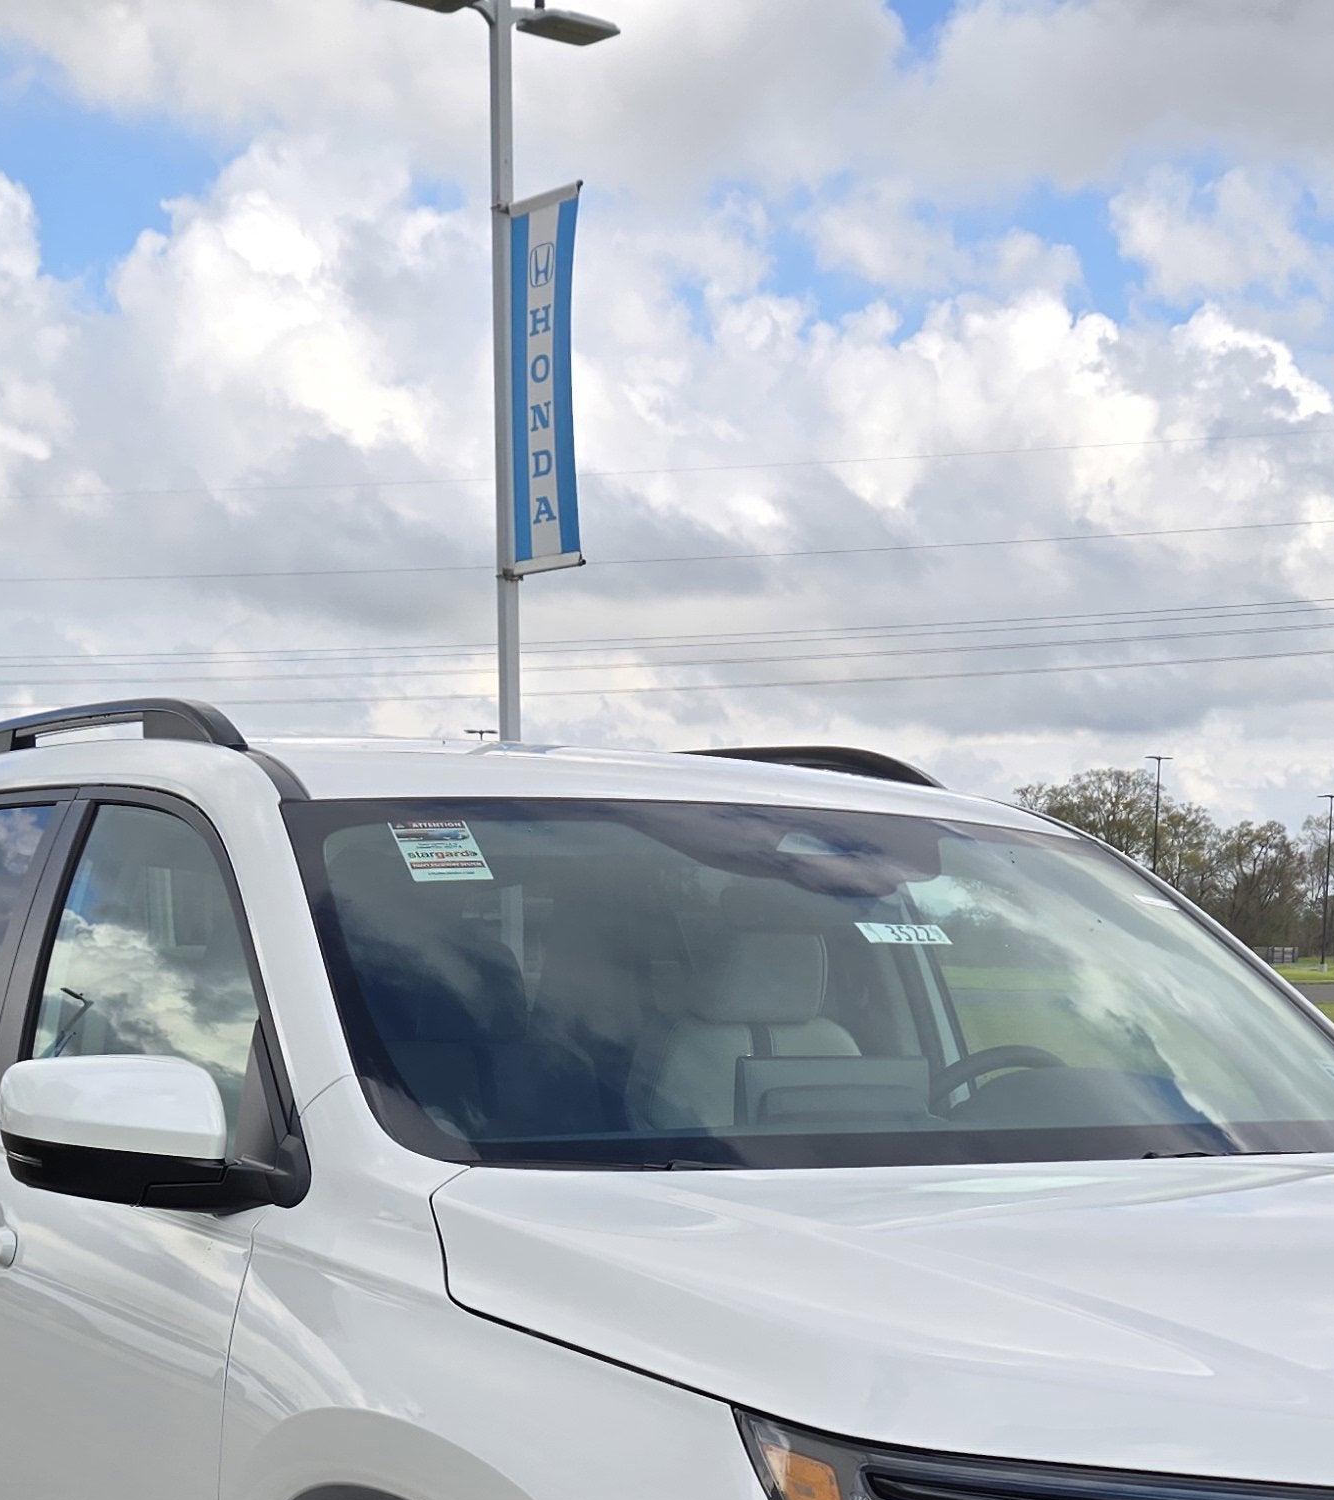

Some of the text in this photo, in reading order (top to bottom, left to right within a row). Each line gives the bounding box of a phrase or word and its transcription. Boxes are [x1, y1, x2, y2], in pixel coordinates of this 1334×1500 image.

[528, 305, 557, 525] HONDA
[411, 821, 462, 829] ATTENTION
[884, 925, 937, 942] 3522
